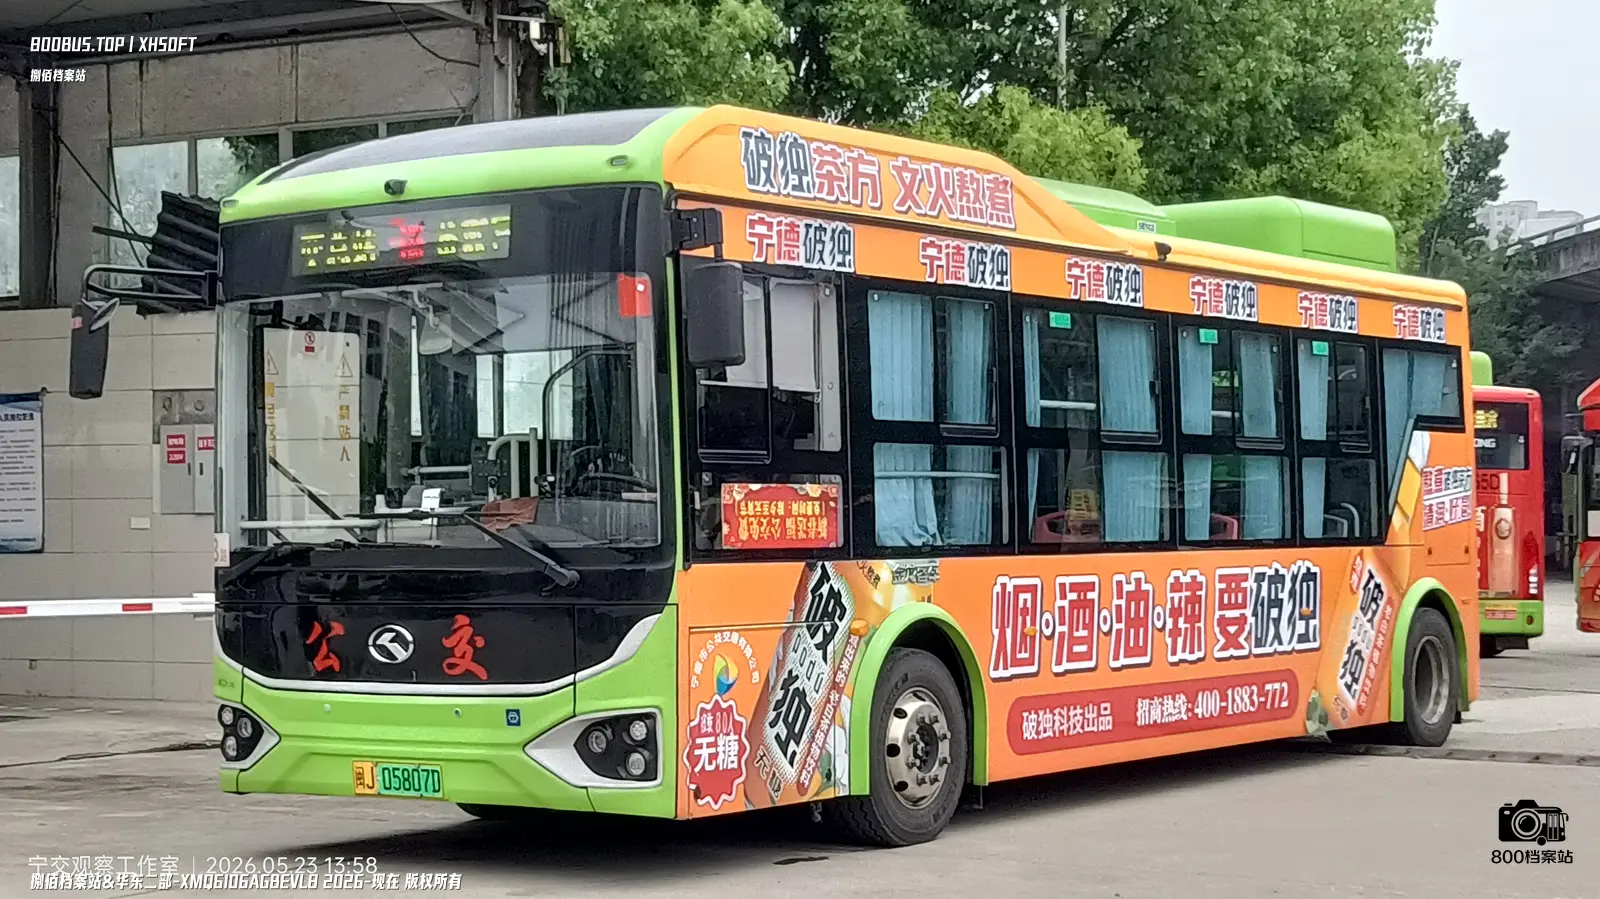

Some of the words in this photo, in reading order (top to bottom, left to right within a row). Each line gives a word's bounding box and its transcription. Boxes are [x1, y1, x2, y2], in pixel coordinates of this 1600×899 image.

[740, 127, 882, 207] 破独茶方
[889, 155, 1016, 229] 文火熬煮
[746, 213, 855, 272] 宁德破独
[919, 236, 1012, 291] 宁德破独
[1065, 257, 1143, 307] 宁德破独
[1189, 275, 1258, 322] 宁德破独
[1298, 291, 1358, 334] 宁德破独
[1392, 304, 1446, 342] 宁德破独
[738, 516, 782, 541] 公交免费
[785, 516, 828, 541] 新春送福
[306, 621, 345, 672] 公
[442, 614, 489, 681] 交
[1022, 702, 1113, 740] 破独科技出品
[693, 734, 739, 774] 无糖
[381, 767, 441, 793] 05807D
